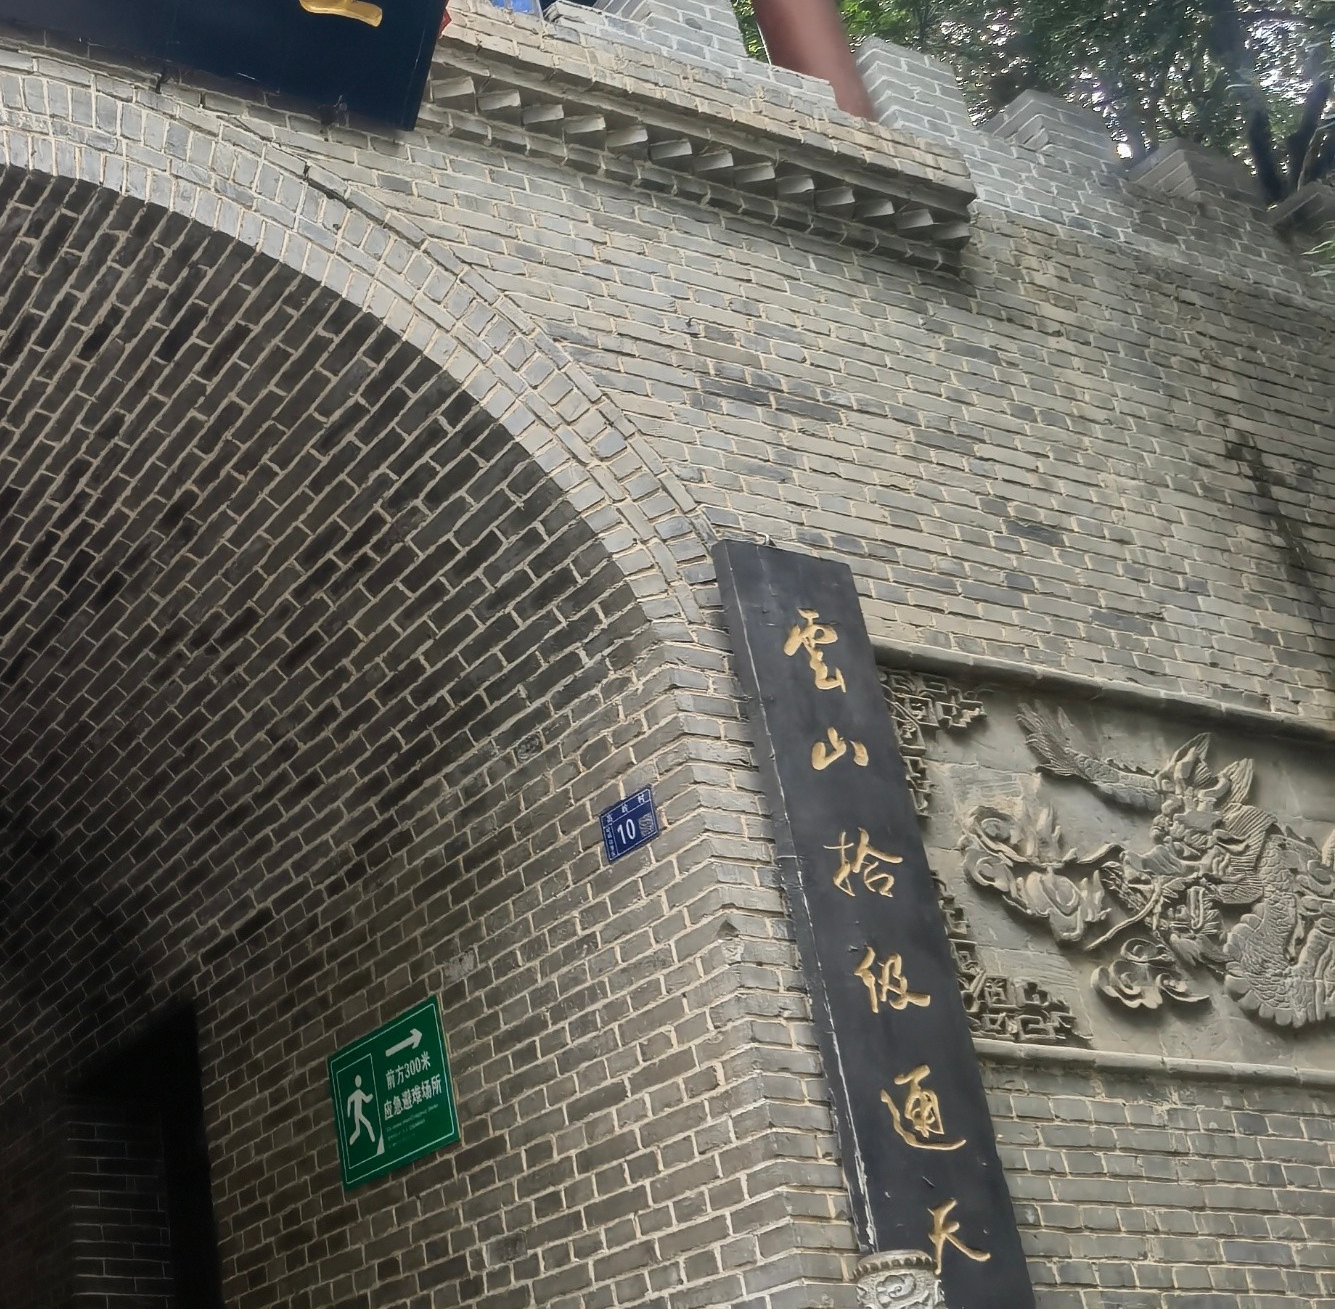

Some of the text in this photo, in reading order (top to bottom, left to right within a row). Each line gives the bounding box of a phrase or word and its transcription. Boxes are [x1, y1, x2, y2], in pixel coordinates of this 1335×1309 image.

[617, 819, 636, 845] 10
[385, 1051, 431, 1091] 前方300米
[384, 1073, 442, 1120] 应急避难场所
